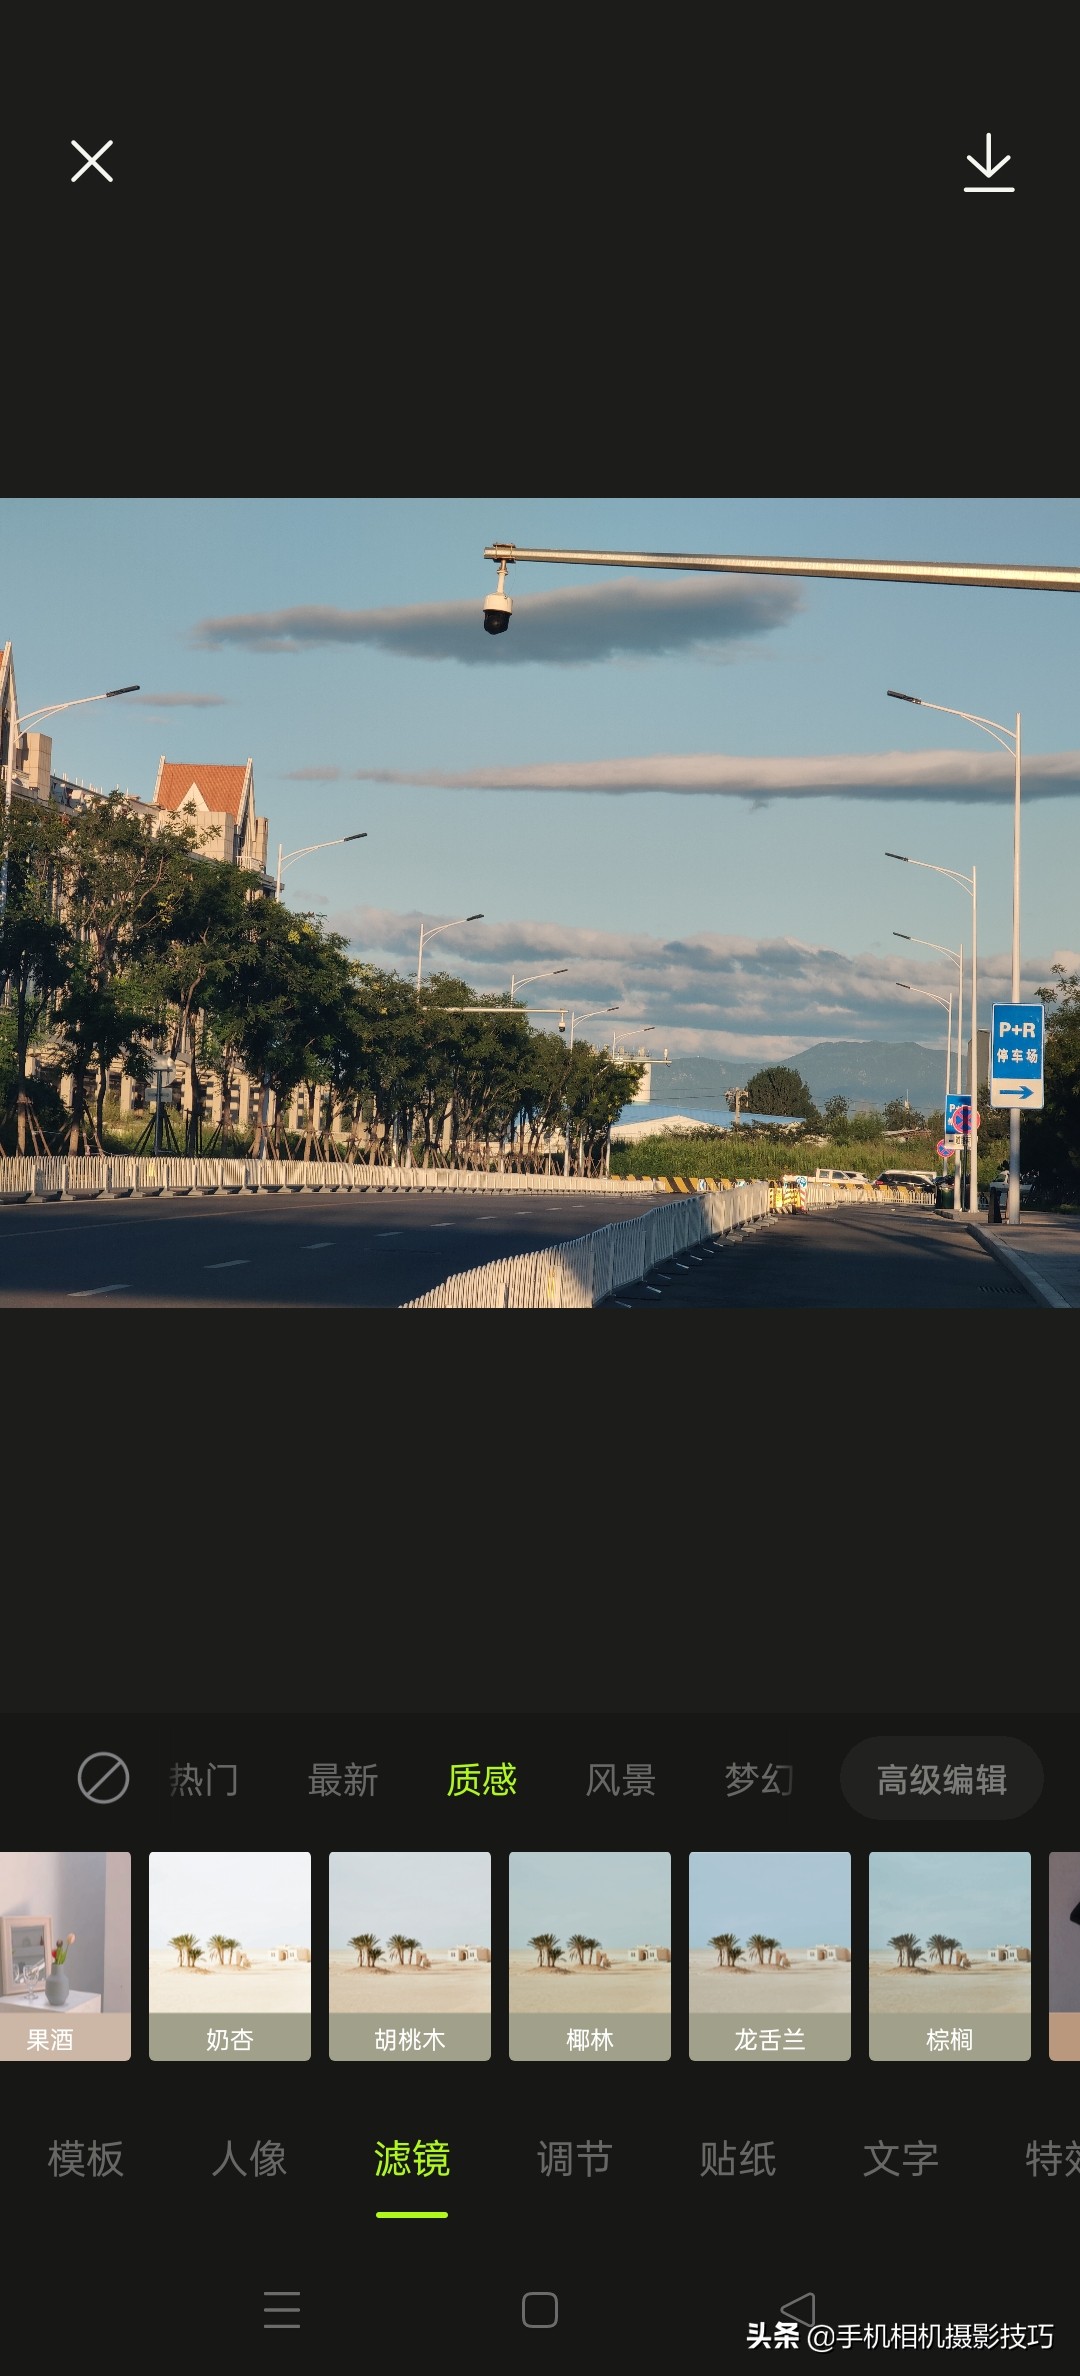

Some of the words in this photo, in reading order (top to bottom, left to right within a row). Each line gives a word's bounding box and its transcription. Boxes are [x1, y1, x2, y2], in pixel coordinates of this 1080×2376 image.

[999, 1021, 1036, 1038] P+R
[996, 1047, 1038, 1064] 停车场
[169, 1762, 237, 1797] 热门
[307, 1761, 379, 1798] 最新
[446, 1761, 518, 1797] 质感
[585, 1763, 656, 1797] 风景
[724, 1761, 793, 1797] 梦幻
[877, 1763, 1008, 1796] 高级编辑
[26, 2028, 74, 2052] 果酒
[206, 2027, 254, 2052] 奶杏
[374, 2027, 446, 2052] 胡桃木
[566, 2027, 614, 2052] 椰林
[734, 2027, 806, 2052] 龙舌兰
[925, 2027, 973, 2052] 棕榈
[47, 2139, 124, 2178] 模板
[211, 2139, 287, 2178] 人像
[373, 2138, 451, 2178] 滤镜
[536, 2139, 613, 2178] 调节
[699, 2139, 777, 2178] 贴纸
[863, 2139, 939, 2178] 文字
